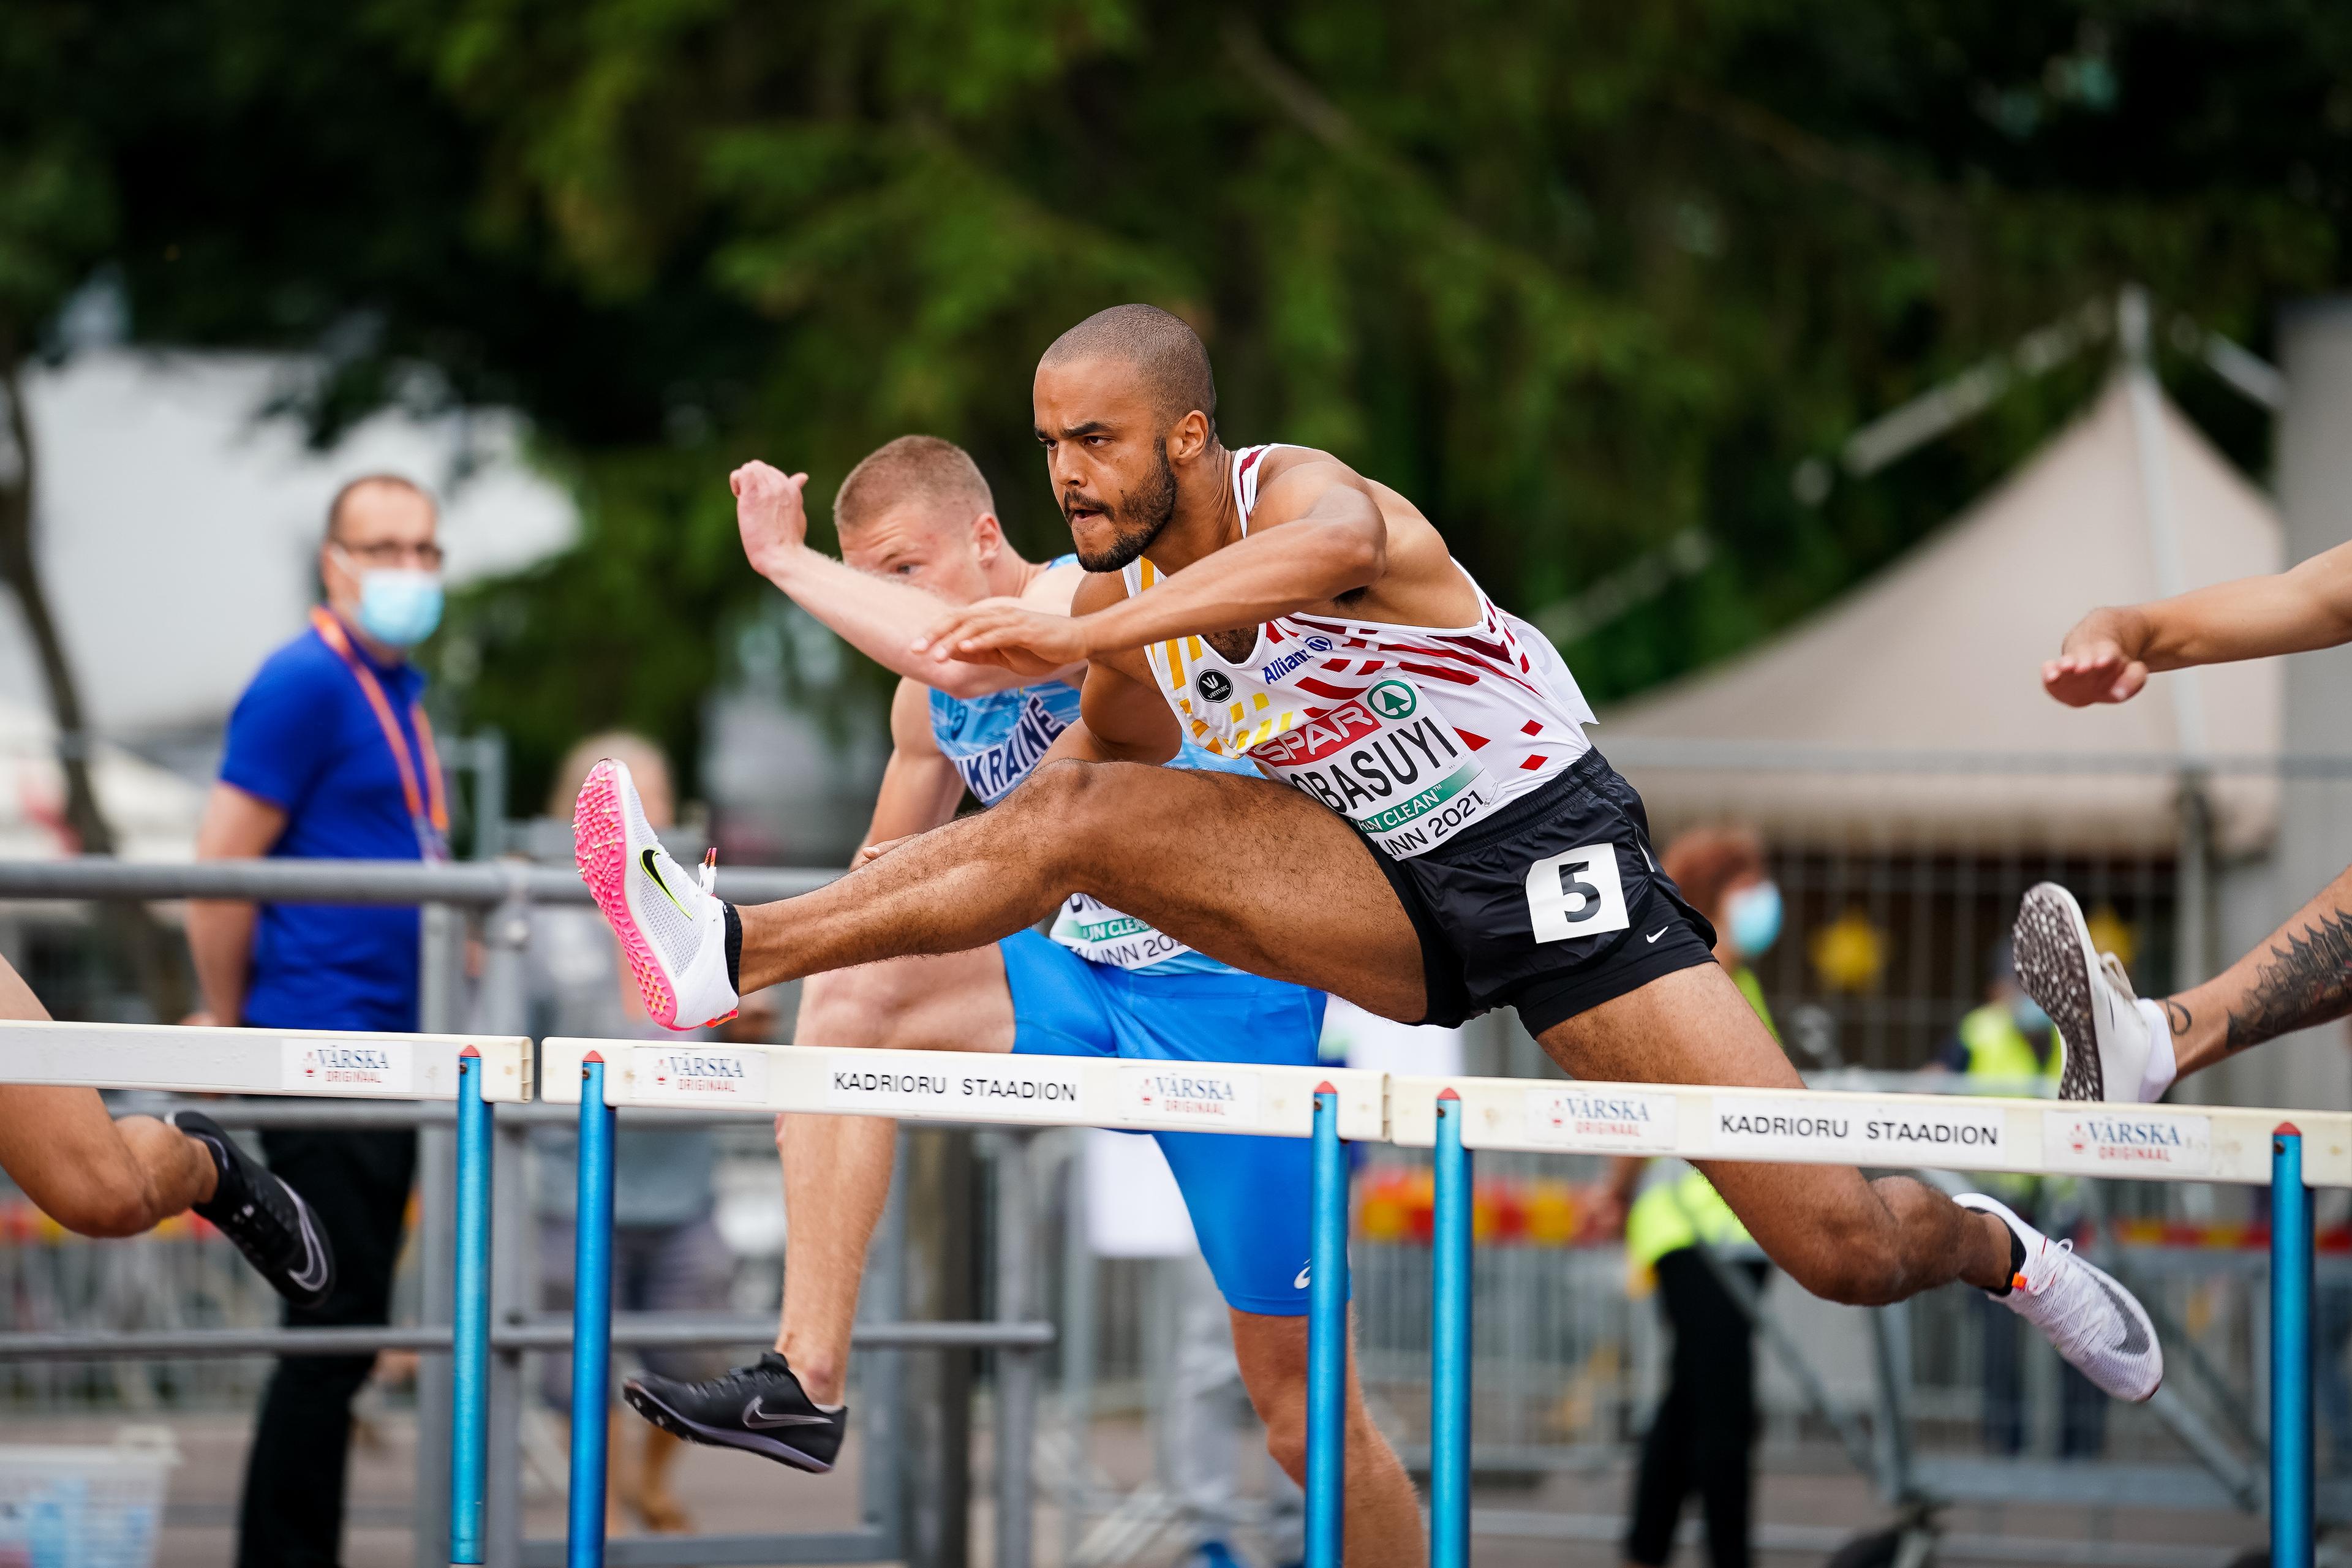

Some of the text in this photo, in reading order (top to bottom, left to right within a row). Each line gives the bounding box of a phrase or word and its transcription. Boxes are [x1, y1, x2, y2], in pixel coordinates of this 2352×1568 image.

[1207, 685, 1230, 698] vermarc
[1255, 706, 1374, 761] SPAR
[1289, 716, 1458, 813] OBASUYI
[1378, 790, 1484, 856] INN 2021
[1559, 861, 1601, 923] 5
[317, 1044, 390, 1069] VÄRSKA
[669, 1052, 745, 1077] VÄRSKA
[833, 1072, 1077, 1101] KADRIORU STAADION
[1155, 1072, 1235, 1101] VÄRSKA
[1567, 1092, 1650, 1121] VÄRSKA
[1720, 1115, 1999, 1146] KADRIORU STAADION
[2087, 1115, 2182, 1147] VÄRSKA
